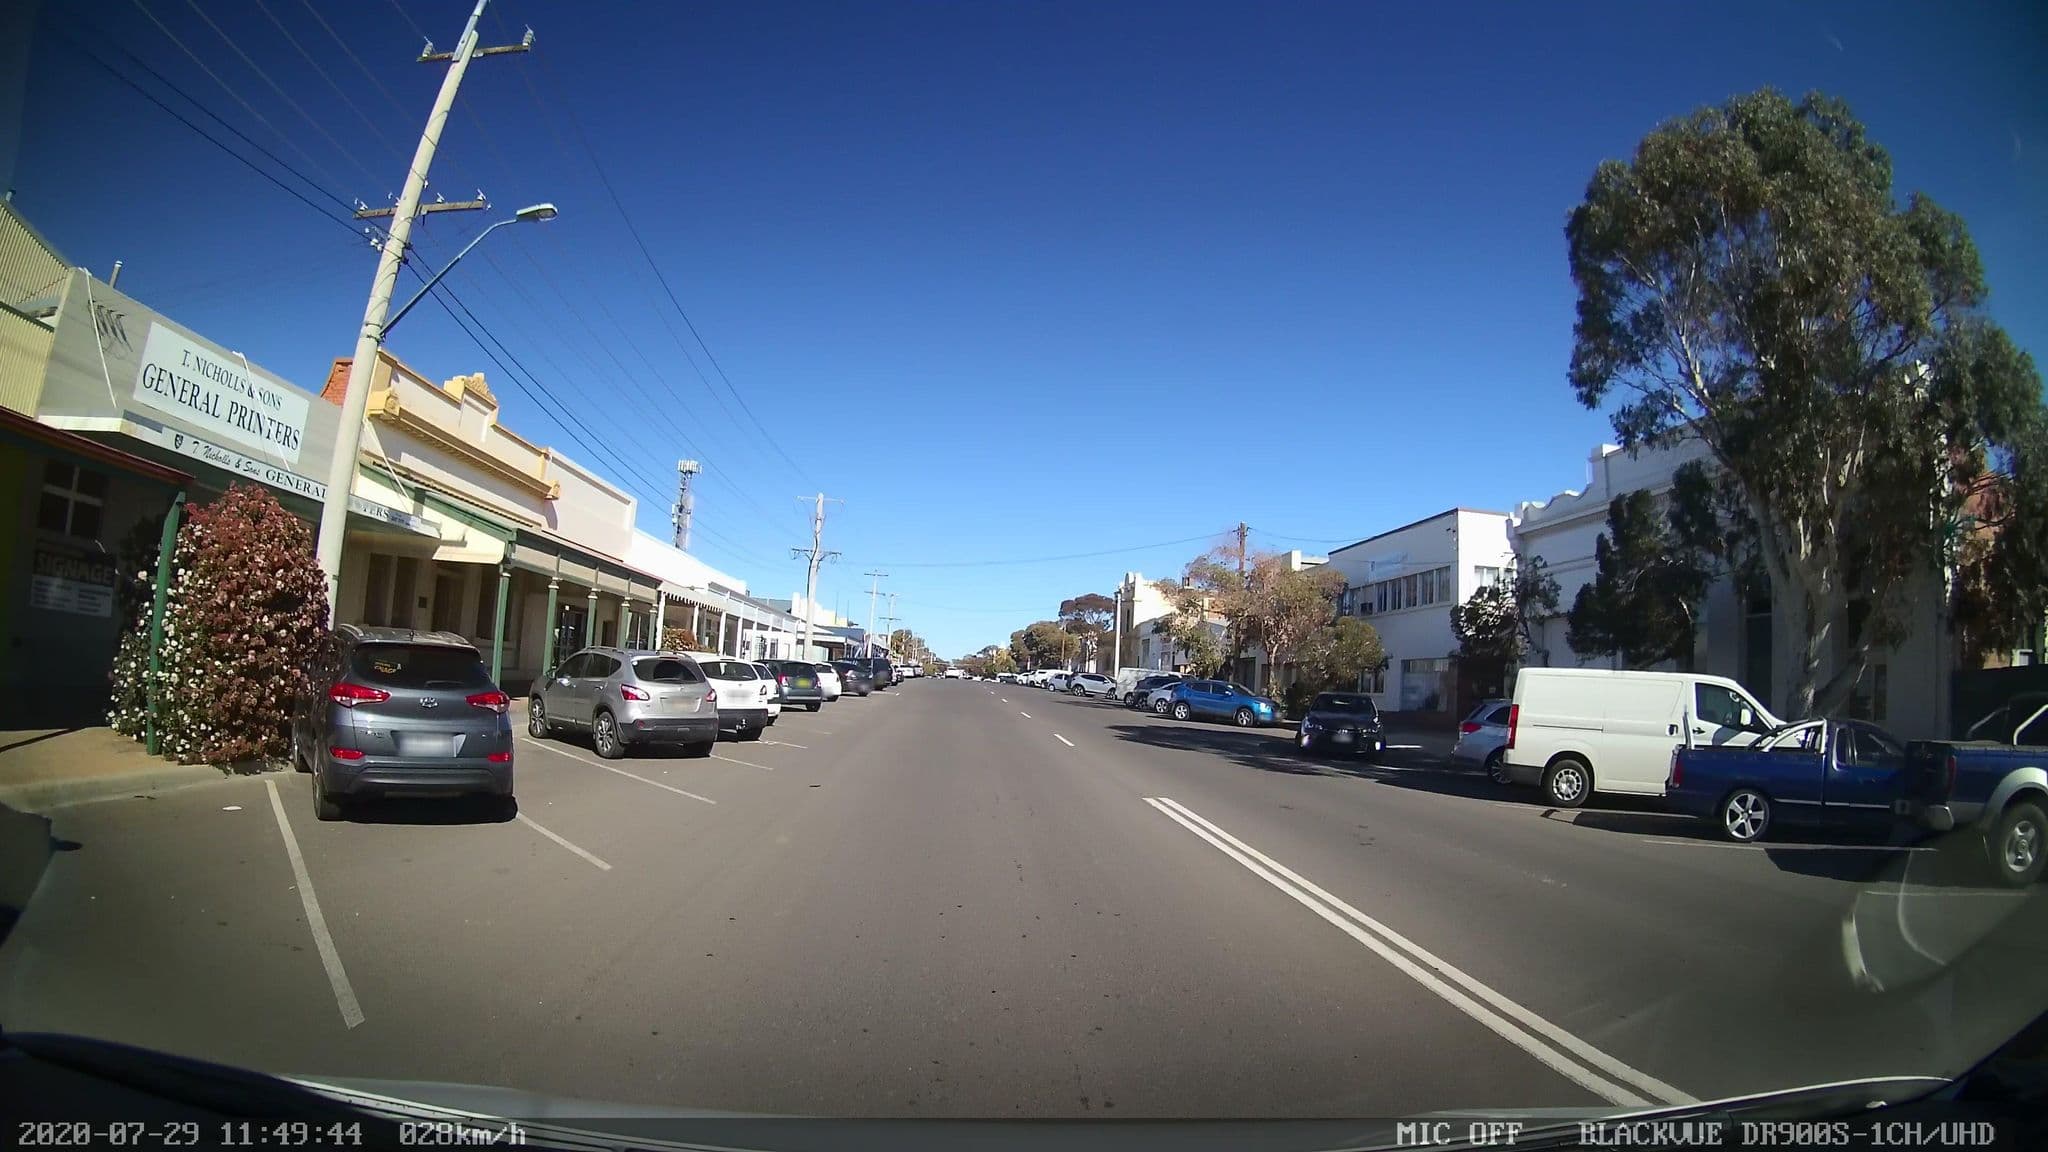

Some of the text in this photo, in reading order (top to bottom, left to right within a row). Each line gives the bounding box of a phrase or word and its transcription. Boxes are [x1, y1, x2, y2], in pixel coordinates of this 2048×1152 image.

[142, 363, 301, 451] GENERAL PRINTERS
[181, 349, 283, 411] T. NICHOLLS & SONS
[192, 441, 200, 454] T
[203, 445, 231, 466] Nicholls
[235, 458, 241, 468] &
[243, 461, 261, 476] Sons
